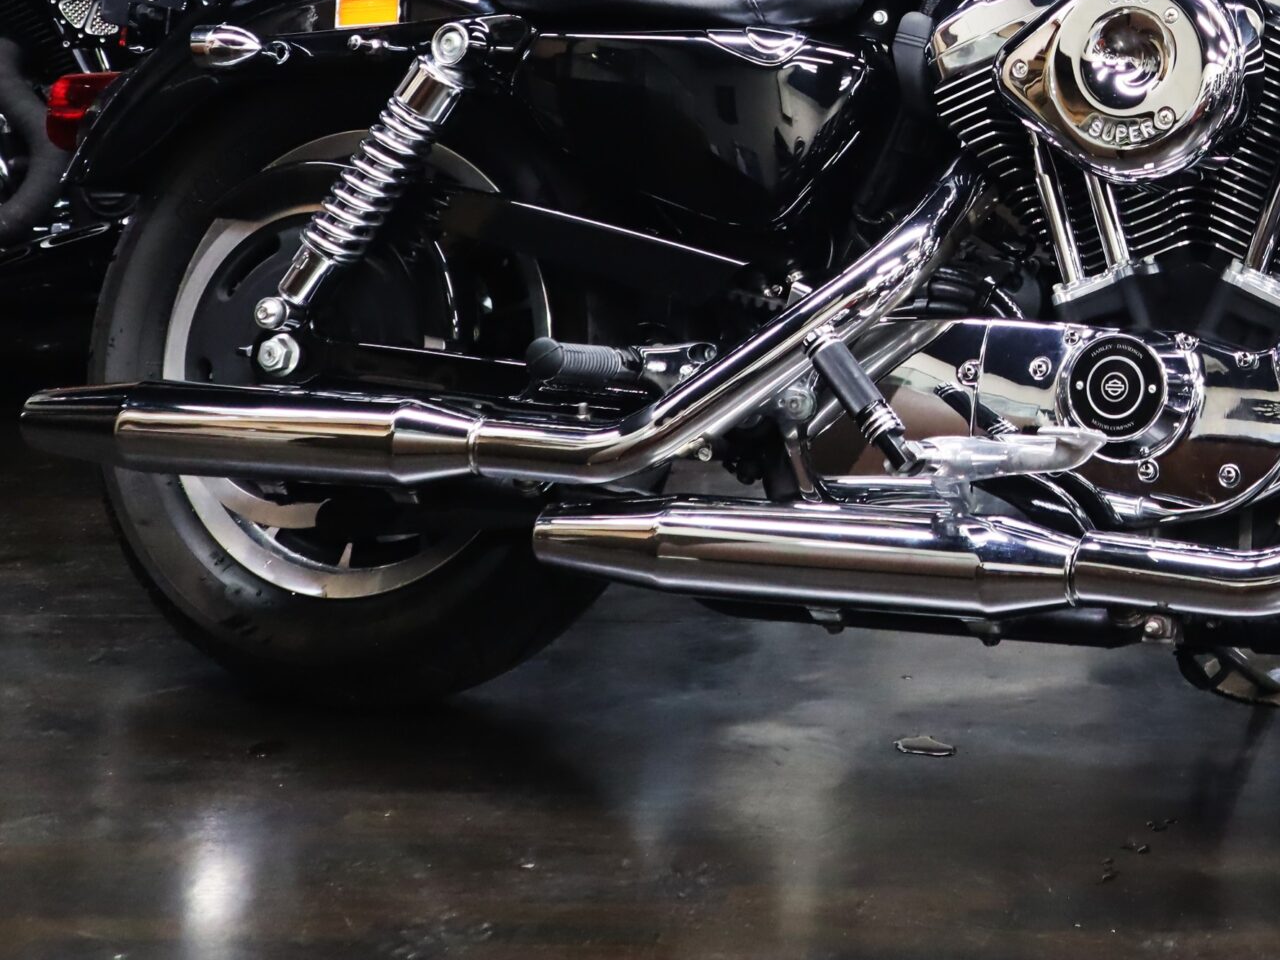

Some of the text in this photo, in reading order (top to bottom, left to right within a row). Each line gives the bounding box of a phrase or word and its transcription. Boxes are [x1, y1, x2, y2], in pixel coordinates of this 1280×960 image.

[1088, 118, 1156, 143] SUPER
[1091, 343, 1143, 359] HARLEY DAVIDSON
